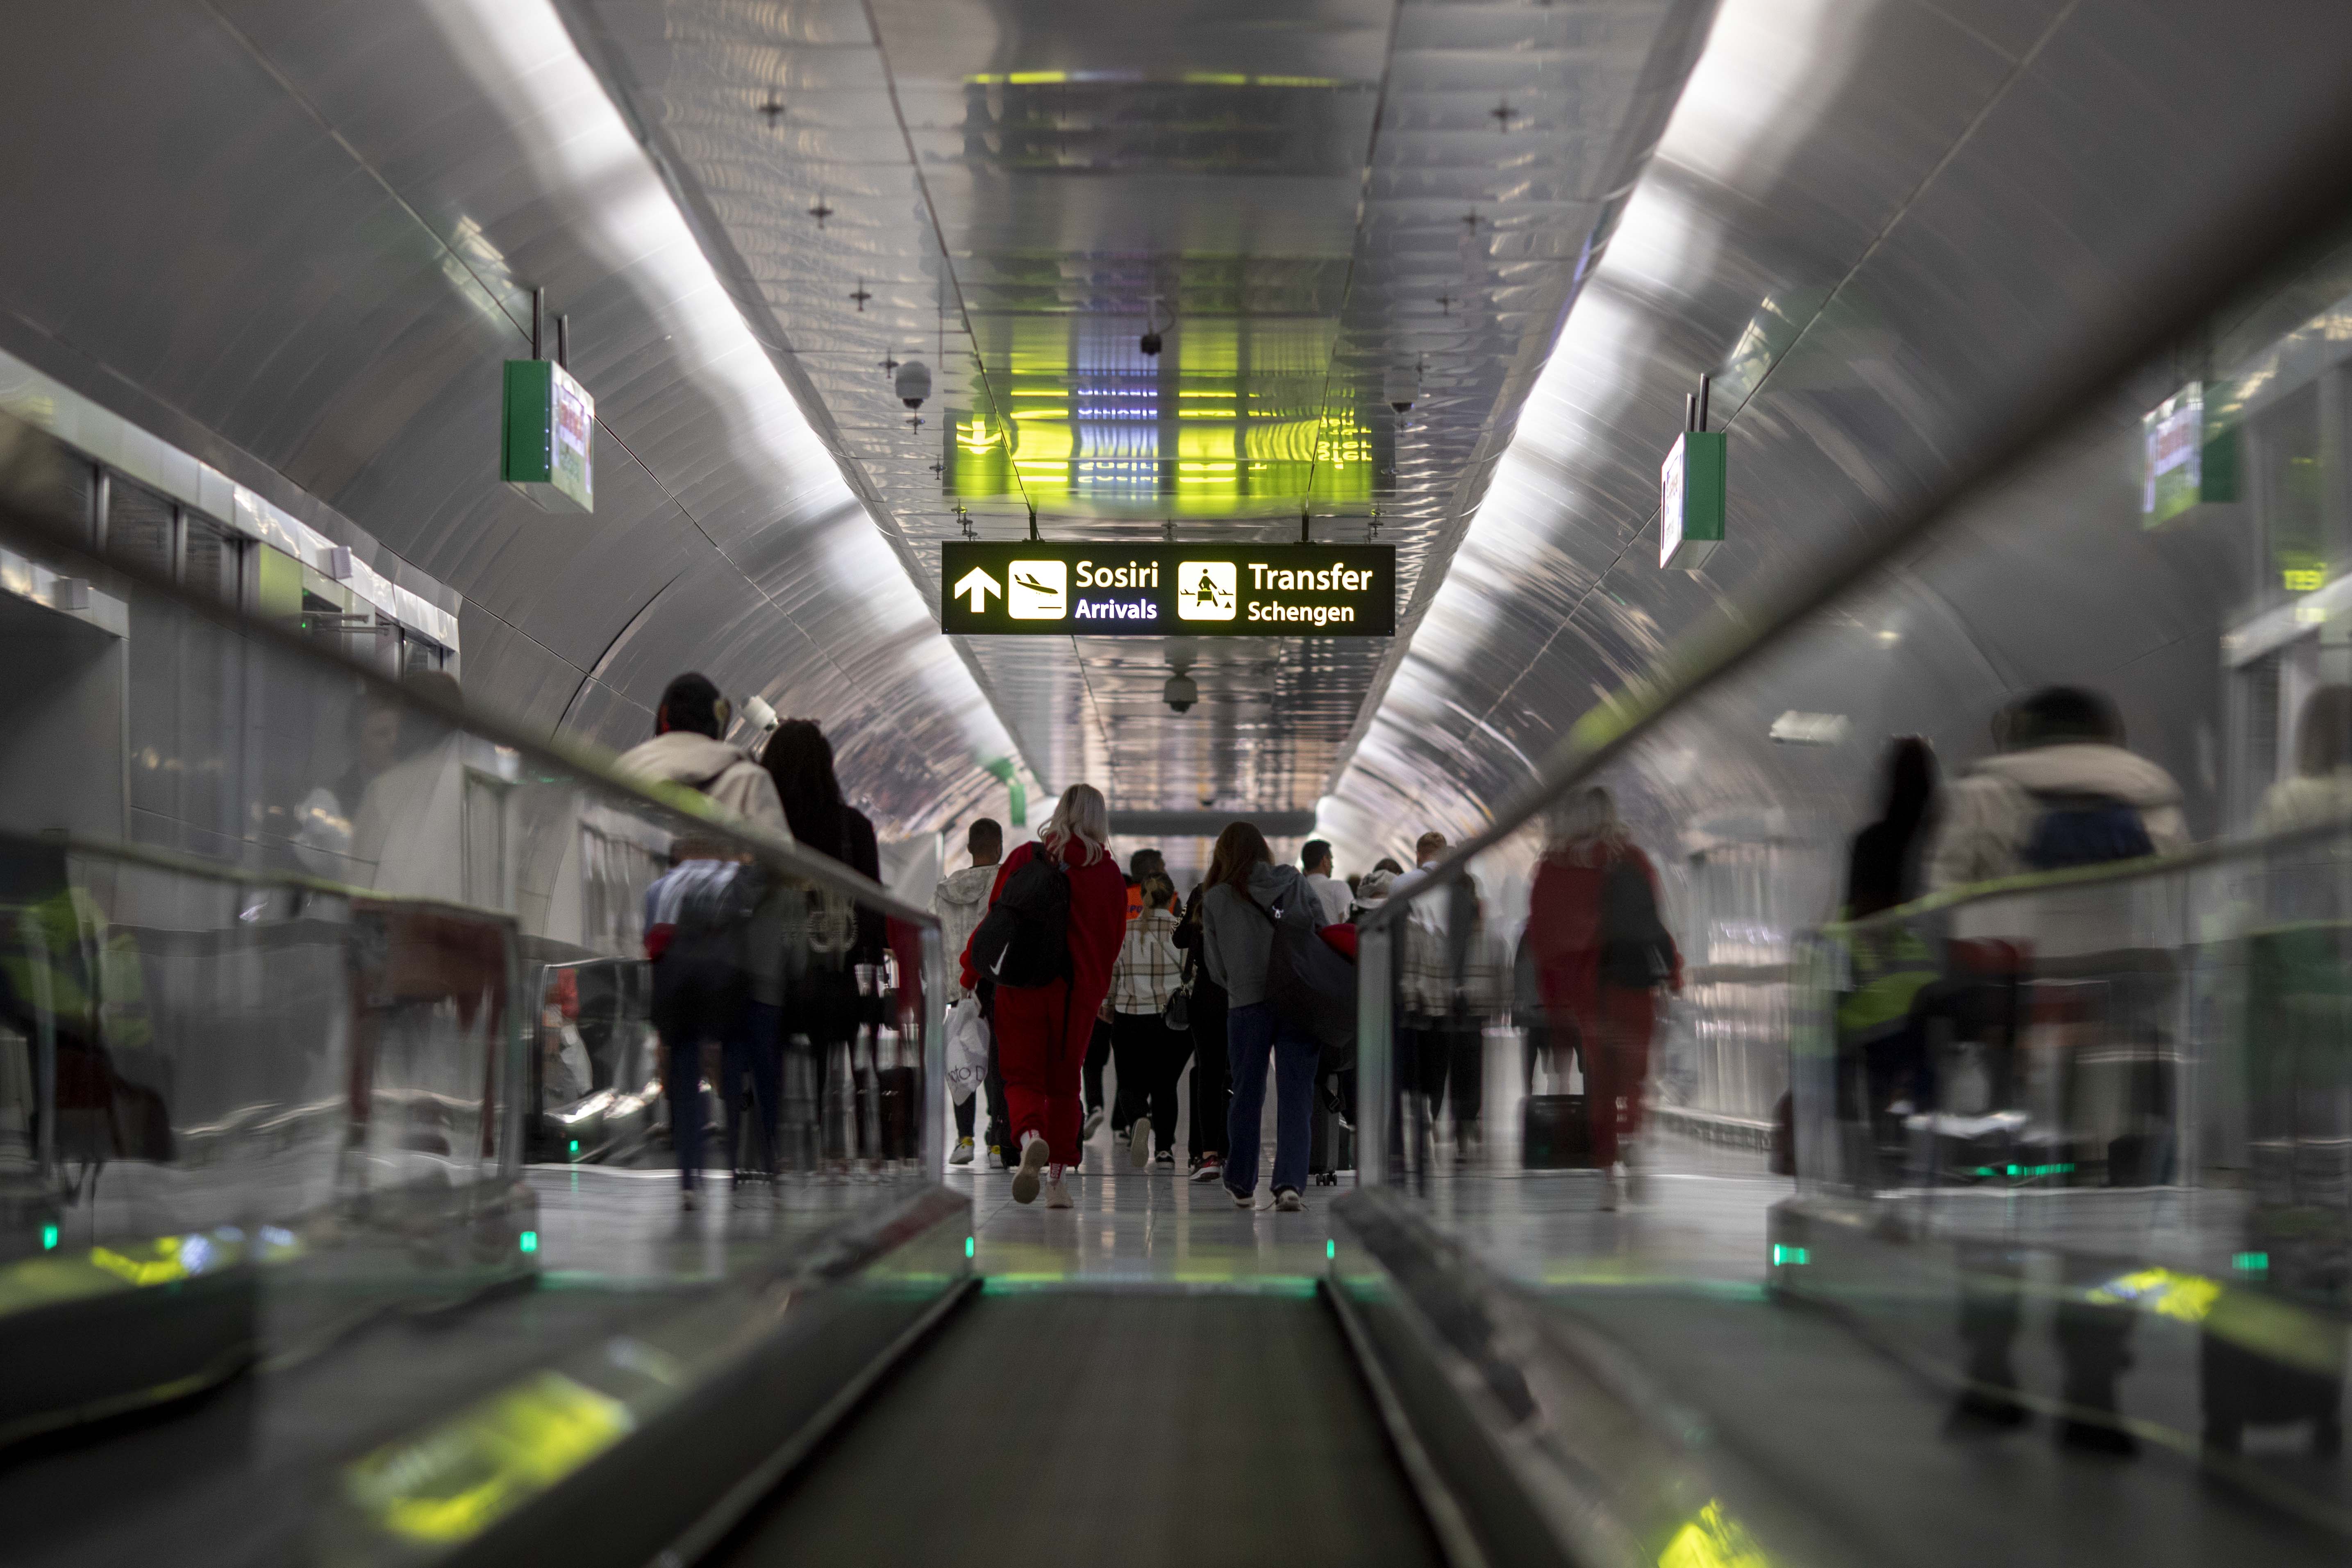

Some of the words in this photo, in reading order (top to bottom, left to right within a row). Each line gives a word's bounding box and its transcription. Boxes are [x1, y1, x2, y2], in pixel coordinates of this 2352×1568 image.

[1076, 561, 1158, 587] Sosiri
[1248, 562, 1373, 591] Transfer
[1075, 598, 1157, 619] Arrivals
[1248, 601, 1354, 626] Schengen
